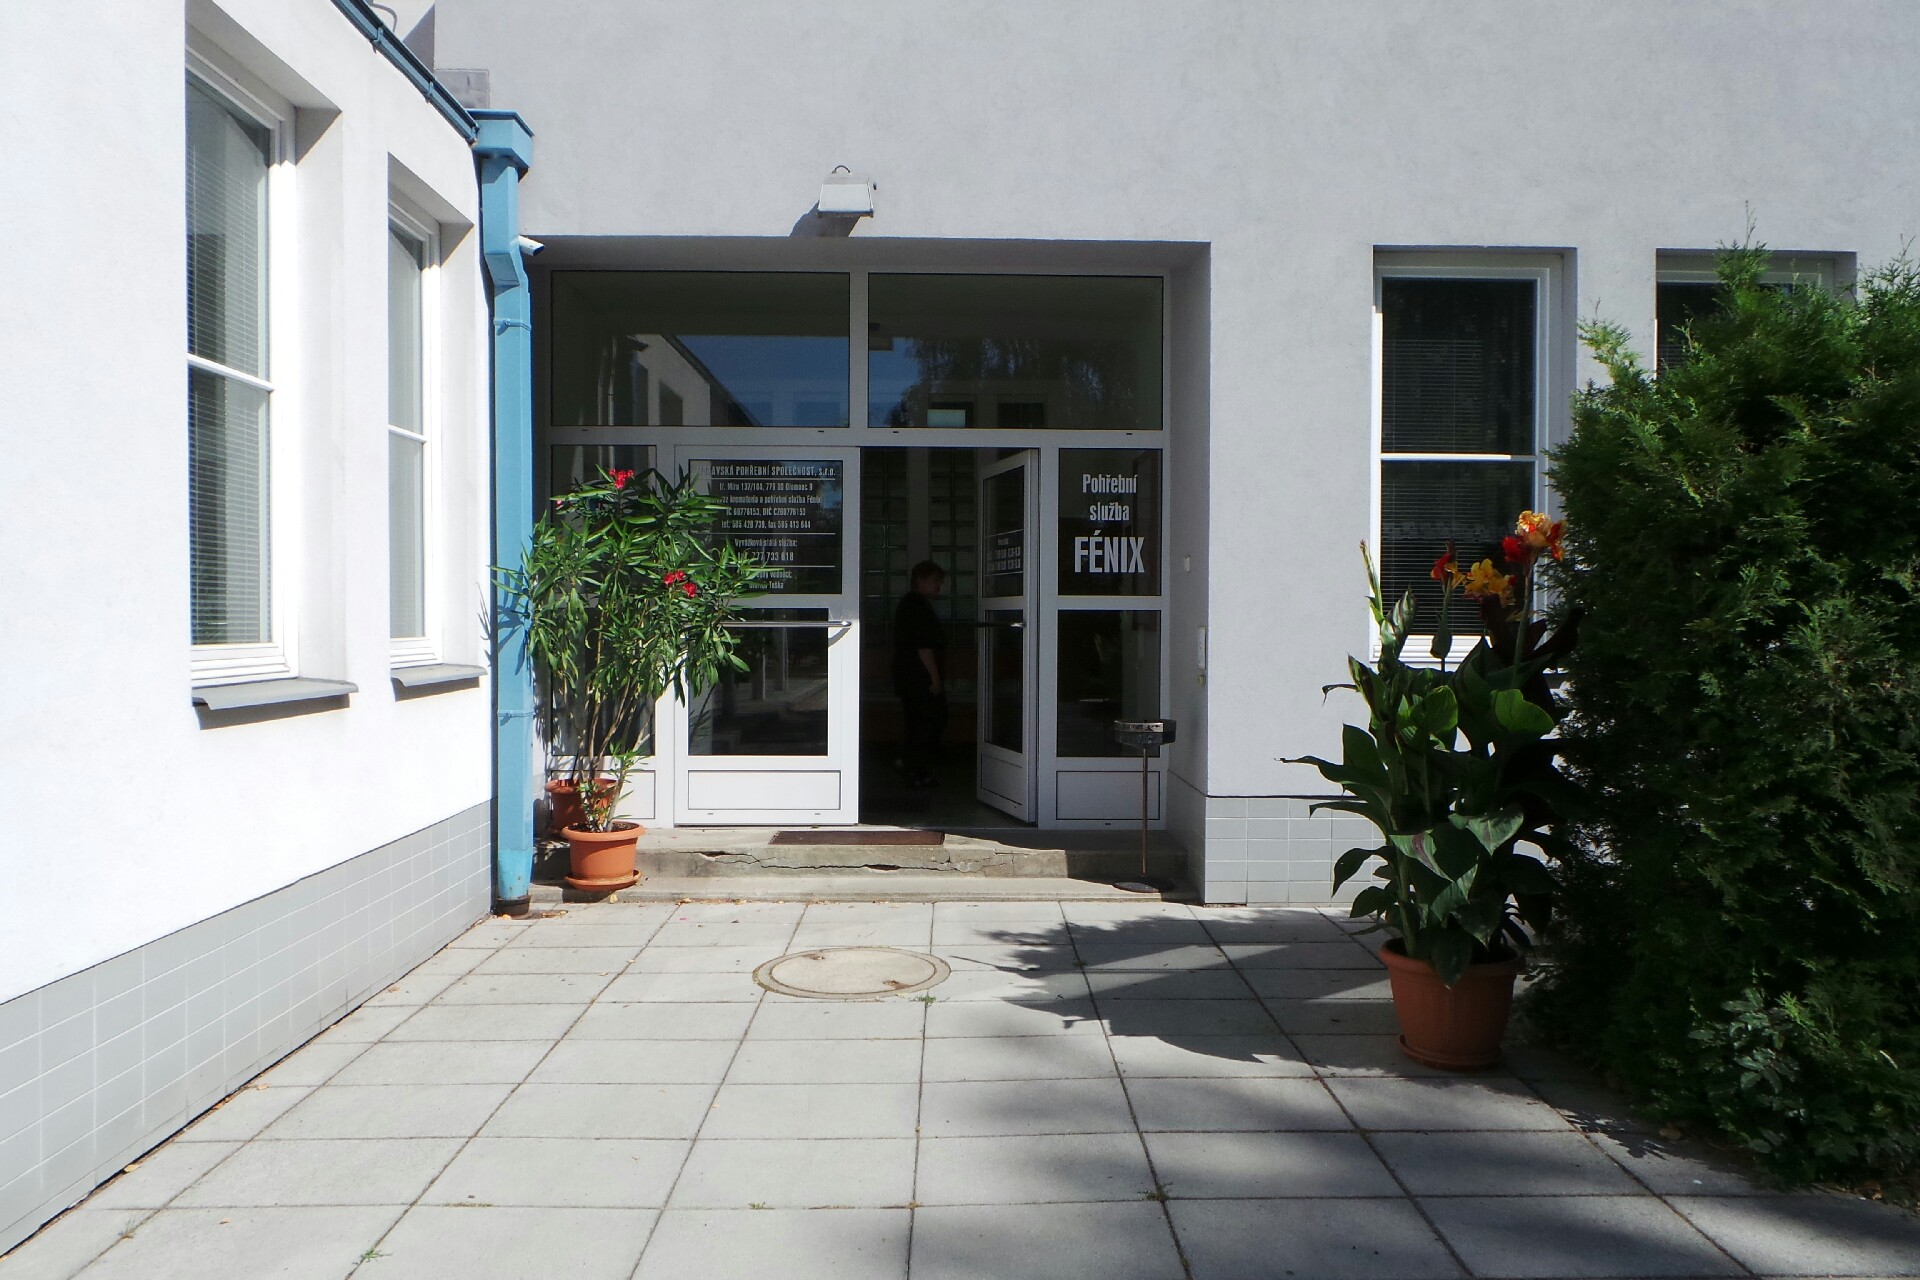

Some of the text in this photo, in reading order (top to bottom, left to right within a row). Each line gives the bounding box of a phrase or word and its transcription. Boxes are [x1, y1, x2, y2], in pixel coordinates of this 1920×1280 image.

[735, 464, 770, 476] POHŘEBNÍ
[818, 467, 836, 476] s.r.o.
[1082, 473, 1138, 493] Pohřební
[1089, 502, 1130, 520] služba
[1074, 530, 1145, 573] FÉNIX
